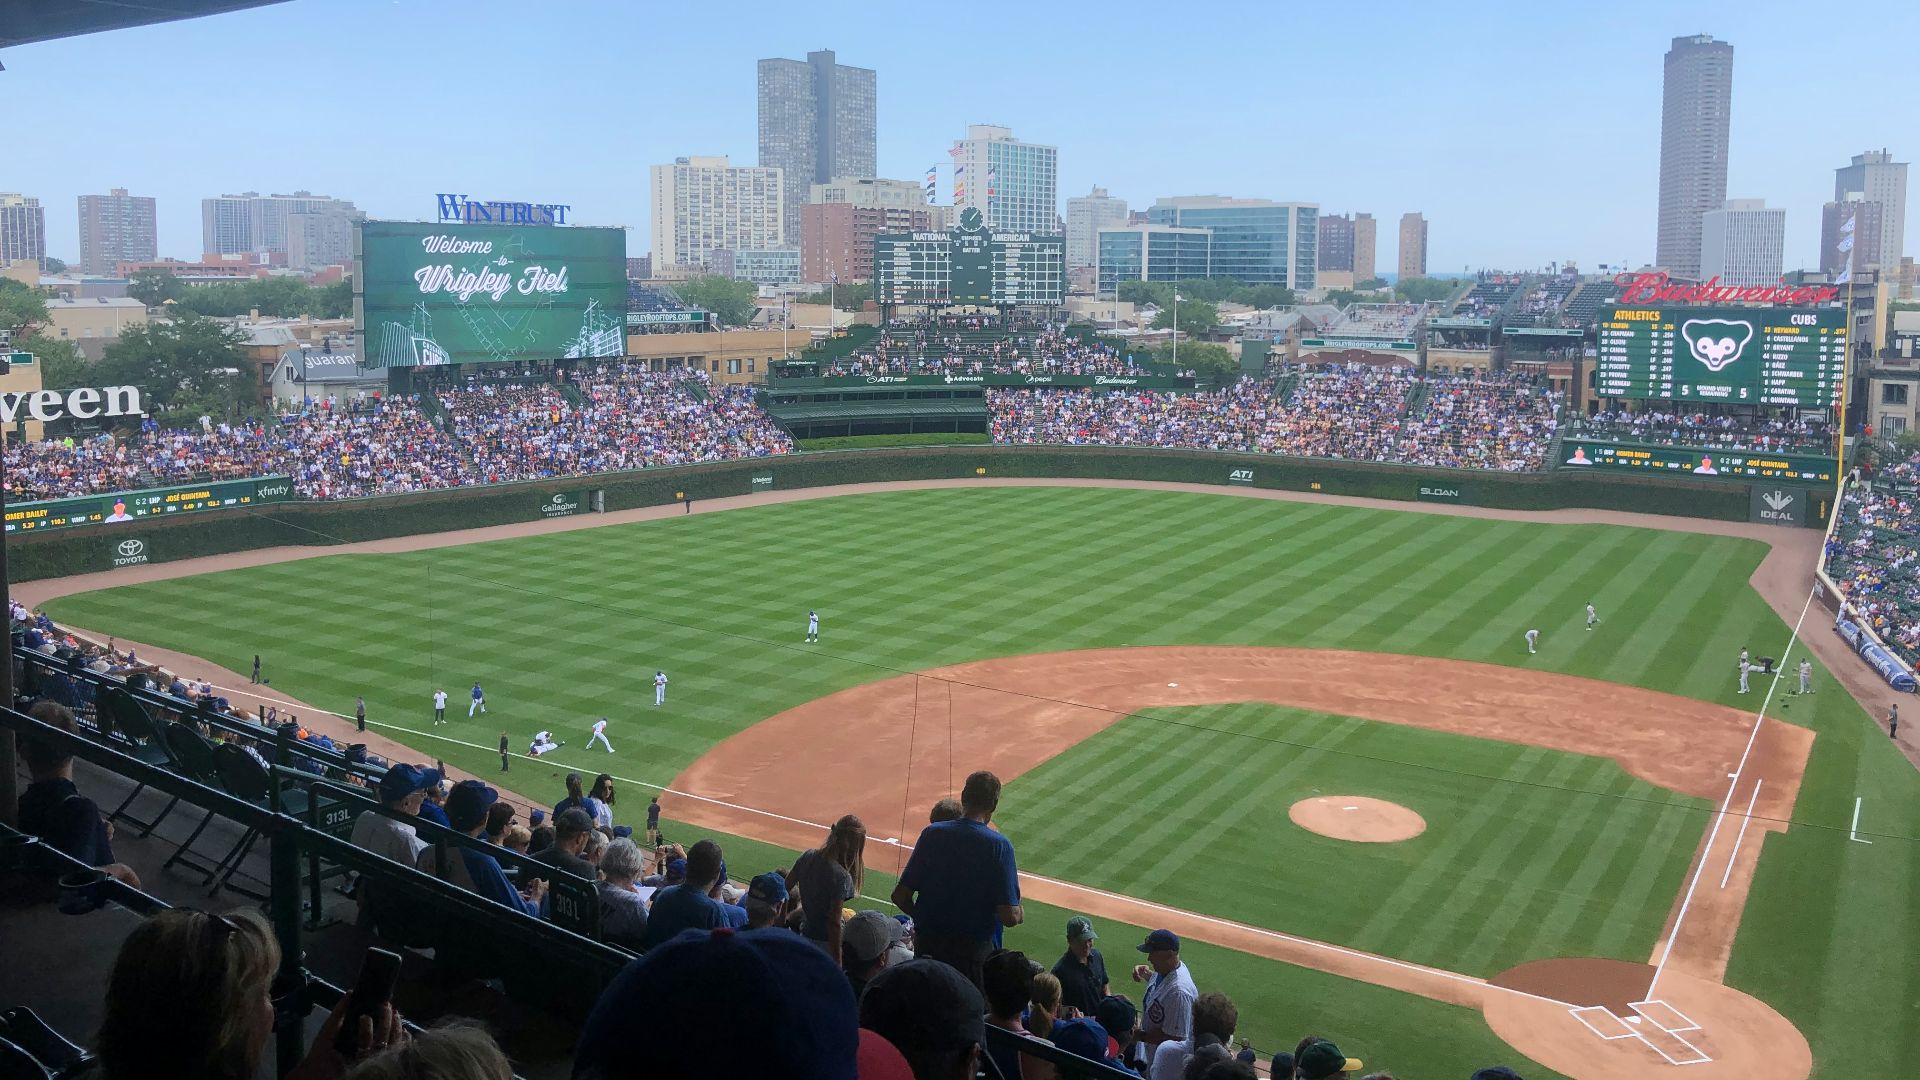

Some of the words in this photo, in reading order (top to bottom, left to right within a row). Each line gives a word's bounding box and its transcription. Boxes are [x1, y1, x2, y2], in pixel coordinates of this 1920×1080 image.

[436, 193, 570, 224] WINTRUST
[913, 233, 951, 241] NATIONAL
[991, 233, 1030, 242] AMERICAN
[422, 234, 493, 254] Welcome
[414, 264, 512, 302] Wrigley
[1614, 271, 1839, 305] Budweiser
[1614, 310, 1660, 321] ATHLETICS
[1790, 314, 1817, 326] CUBS
[1034, 375, 1052, 383] pepsi
[1094, 375, 1138, 385] Budweiser
[1681, 384, 1689, 396] 5
[1739, 387, 1747, 399] 5
[1761, 460, 1789, 469] QUINTANA
[1229, 469, 1254, 479] ATI
[165, 493, 180, 502] JOSÉ
[181, 491, 211, 500] QUINTANA
[257, 485, 289, 499] xfinity
[1420, 487, 1459, 497] SLOAN
[541, 502, 578, 512] Gallagher
[26, 509, 48, 518] BAILEY
[1760, 510, 1794, 521] IDEAL
[22, 521, 35, 529] 5.20
[113, 554, 148, 566] TOYOTA
[325, 808, 352, 825] 313L
[556, 893, 581, 921] 313L
